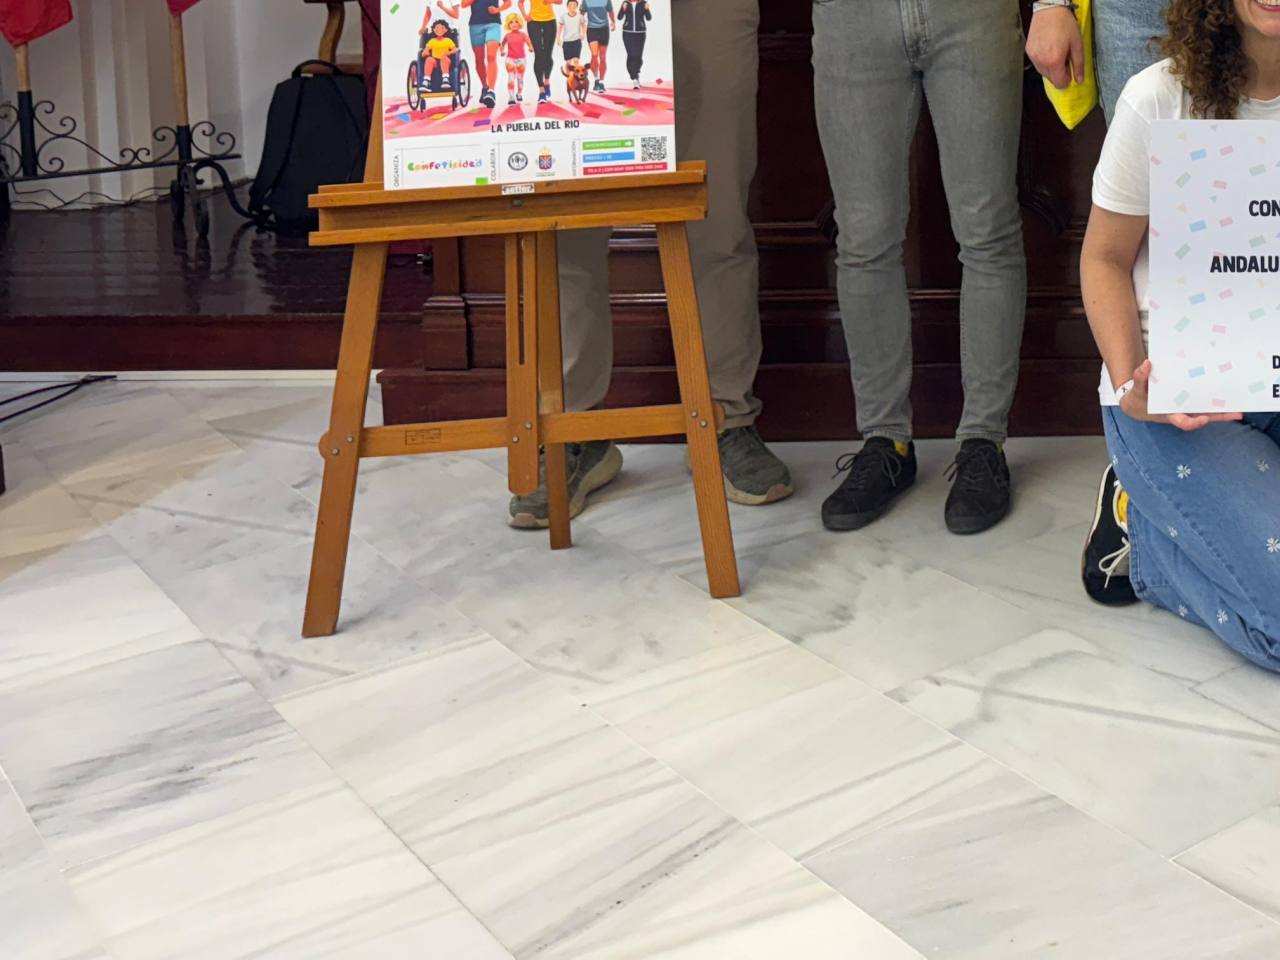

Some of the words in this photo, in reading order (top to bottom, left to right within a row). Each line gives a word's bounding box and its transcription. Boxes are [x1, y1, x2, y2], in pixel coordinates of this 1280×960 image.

[491, 124, 503, 133] LA
[506, 122, 541, 132] PUEBLA
[544, 121, 561, 130] DEL
